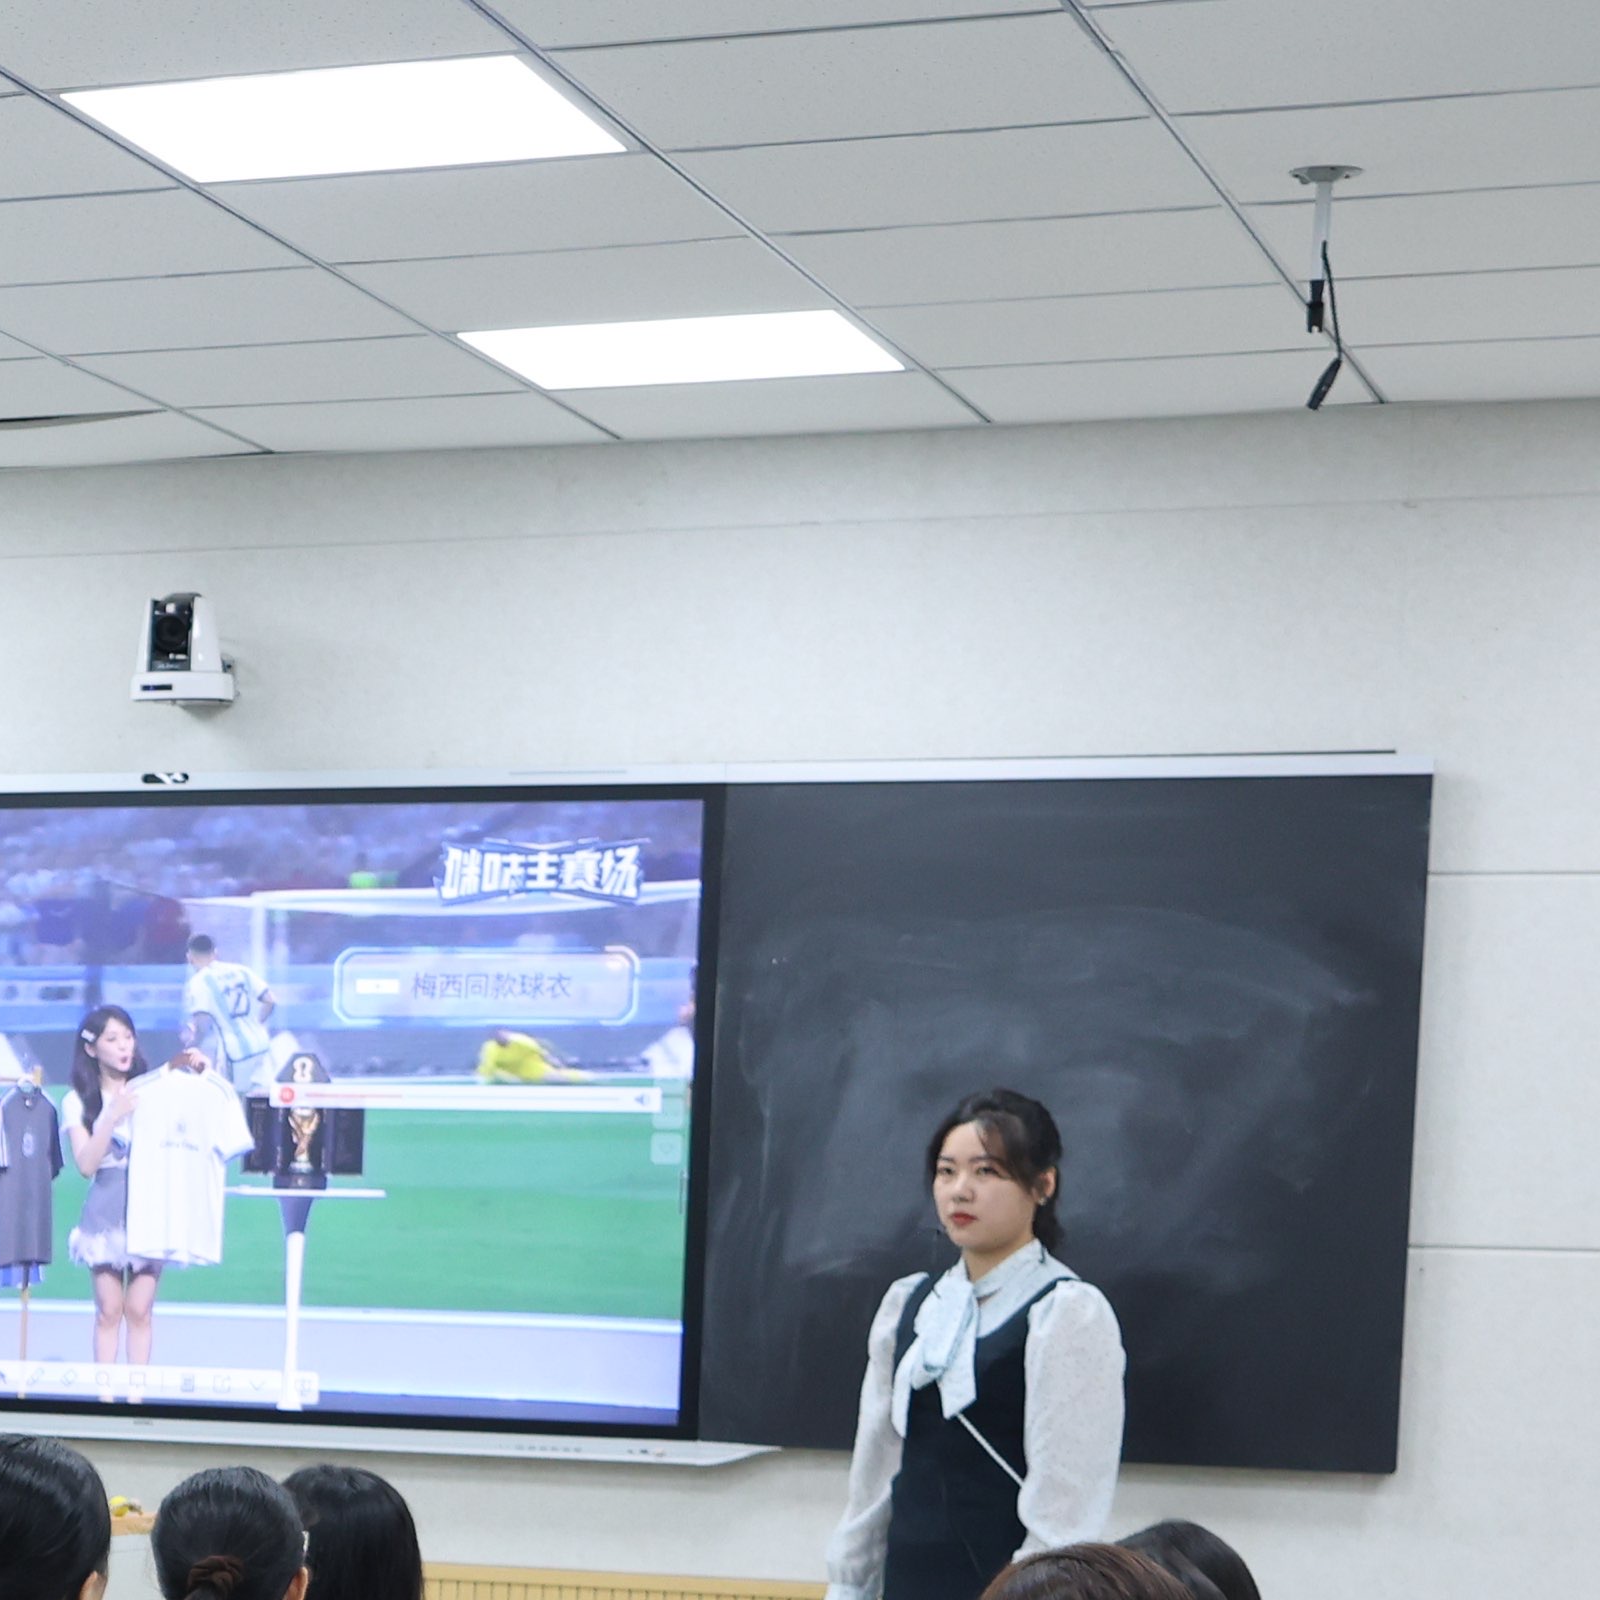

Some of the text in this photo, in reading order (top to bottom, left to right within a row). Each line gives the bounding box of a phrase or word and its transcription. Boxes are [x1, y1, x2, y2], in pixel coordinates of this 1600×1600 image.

[440, 844, 641, 900] 咪咕主赛场
[410, 971, 573, 1001] 梅西同款球衣
